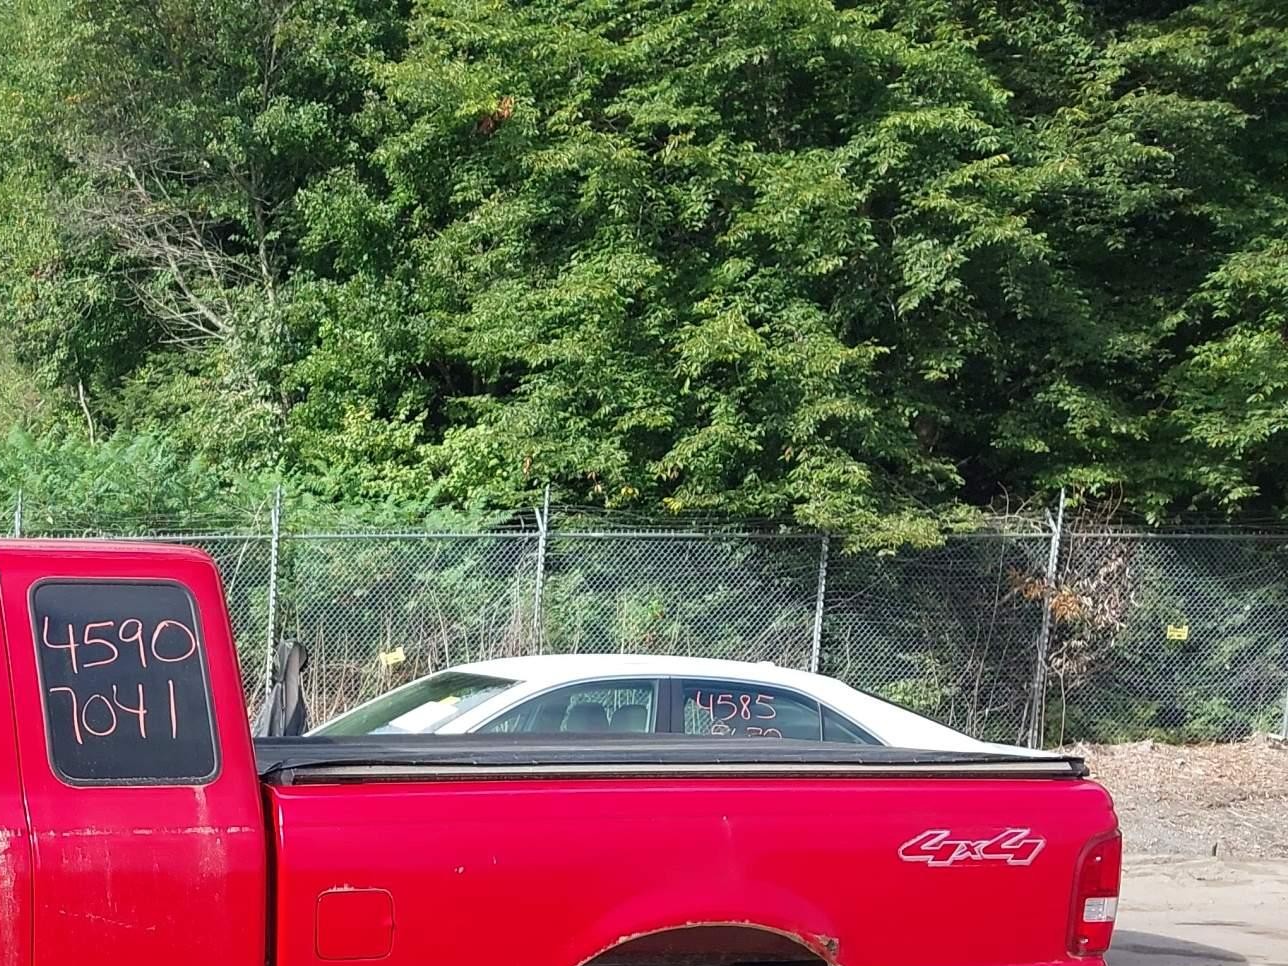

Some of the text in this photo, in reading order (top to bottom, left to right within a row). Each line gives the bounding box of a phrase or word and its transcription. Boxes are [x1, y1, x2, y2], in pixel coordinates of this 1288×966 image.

[42, 616, 196, 674] 4590
[49, 679, 177, 745] 7041
[696, 691, 777, 721] 4585
[898, 828, 1047, 867] 4x4
